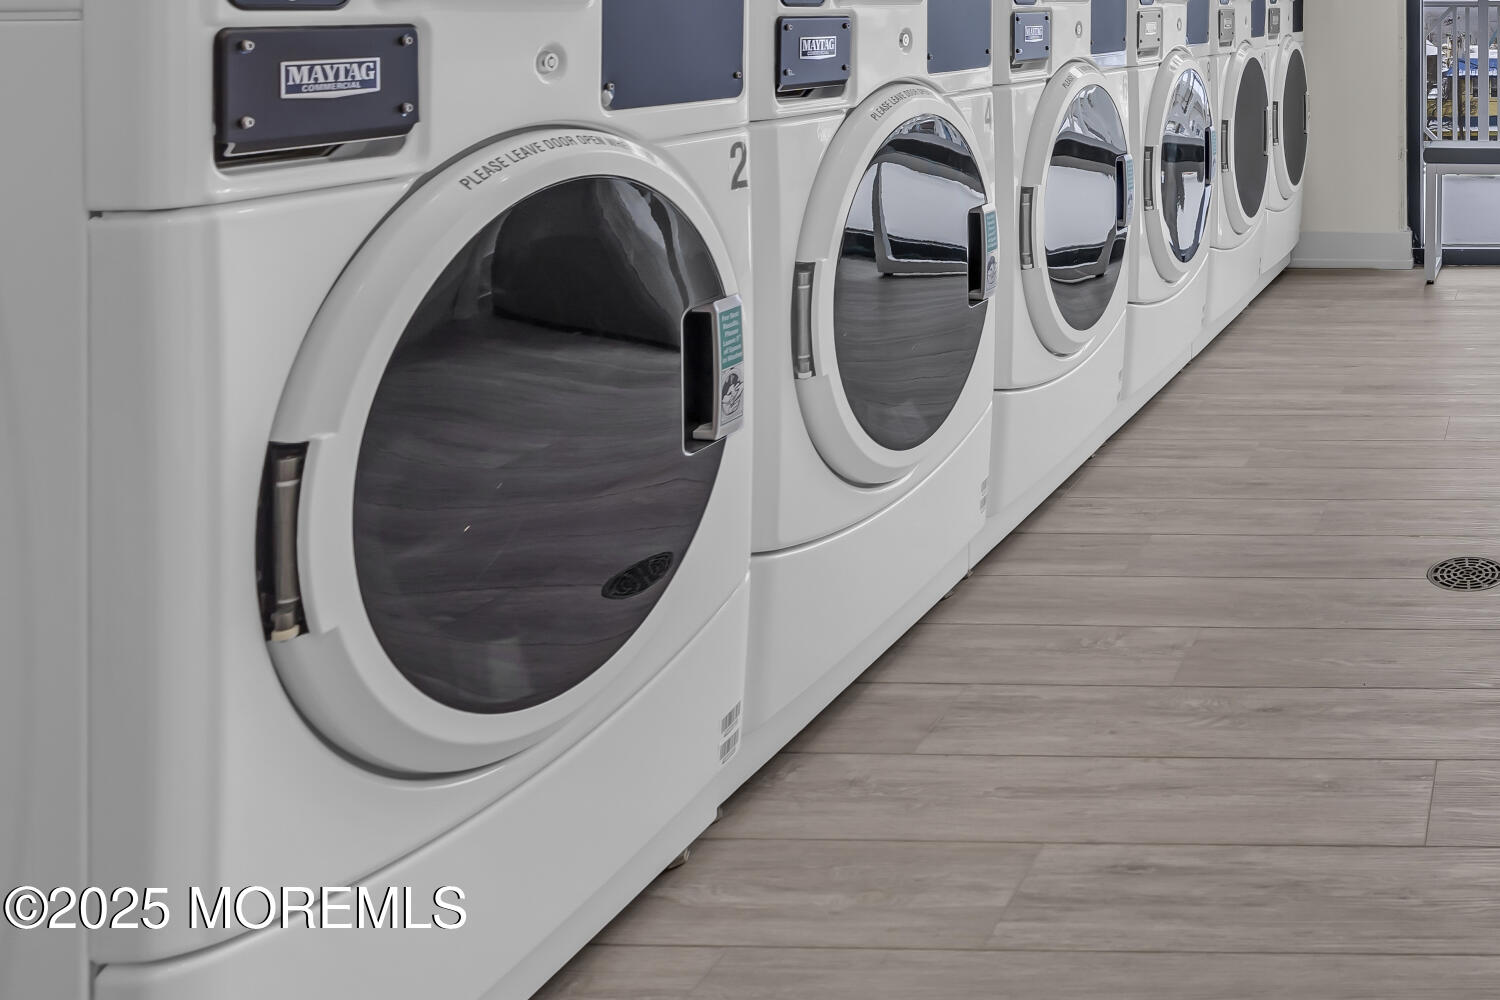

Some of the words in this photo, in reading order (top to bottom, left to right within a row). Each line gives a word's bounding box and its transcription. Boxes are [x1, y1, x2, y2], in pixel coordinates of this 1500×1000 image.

[802, 39, 835, 51] MAYTAG
[286, 62, 376, 86] MAYTAG
[870, 100, 893, 121] PLEASE
[888, 91, 907, 105] LEAVE
[458, 155, 510, 191] PLEASE
[504, 141, 546, 164] LEAVE
[543, 135, 576, 150] DOOR
[729, 141, 748, 190] 2
